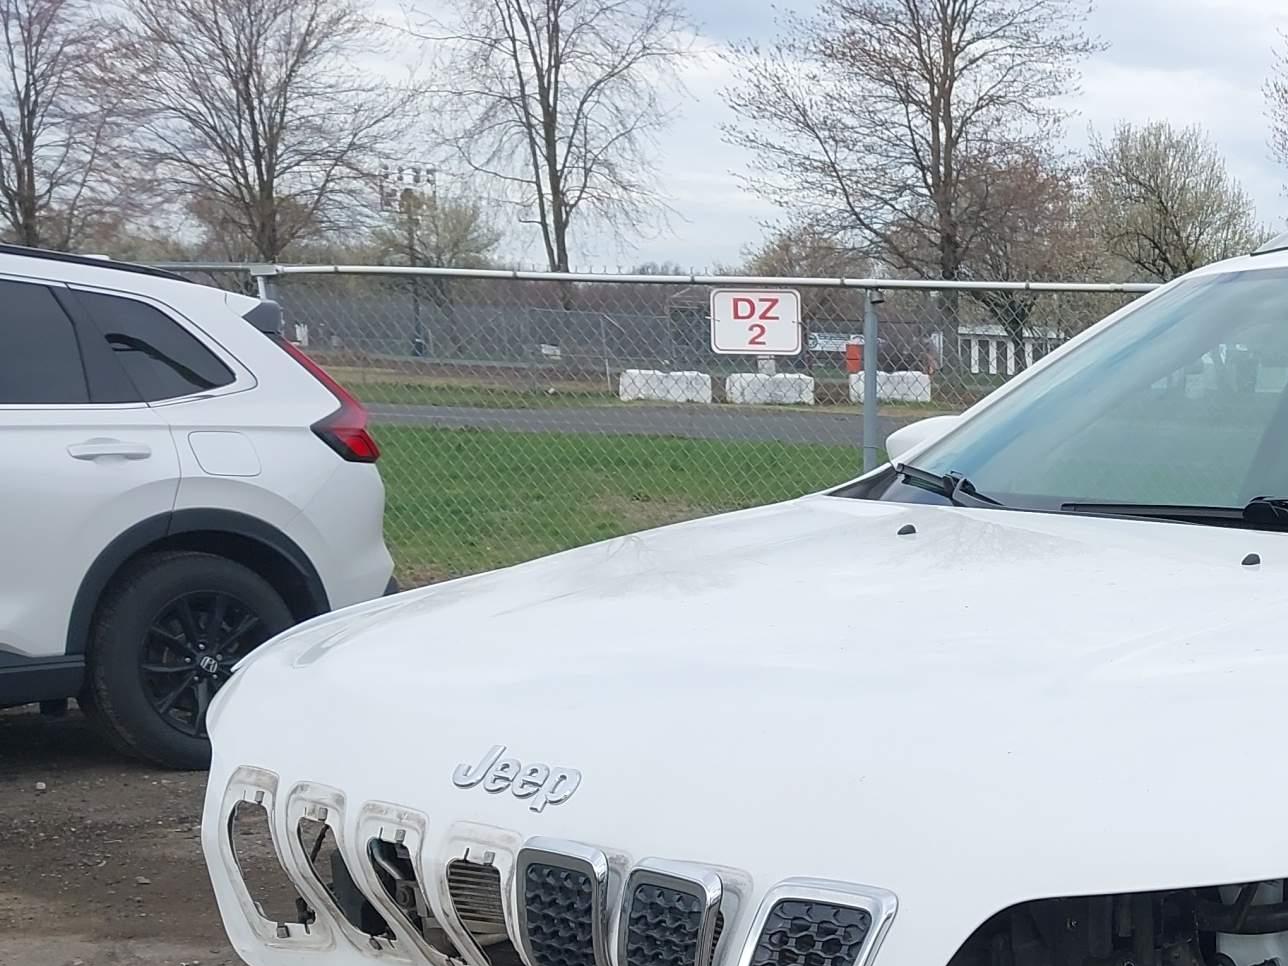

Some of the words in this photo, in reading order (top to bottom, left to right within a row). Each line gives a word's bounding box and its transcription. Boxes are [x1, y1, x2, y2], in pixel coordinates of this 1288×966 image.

[732, 297, 780, 321] DZ
[748, 323, 766, 346] 2
[452, 744, 582, 814] Jeep
